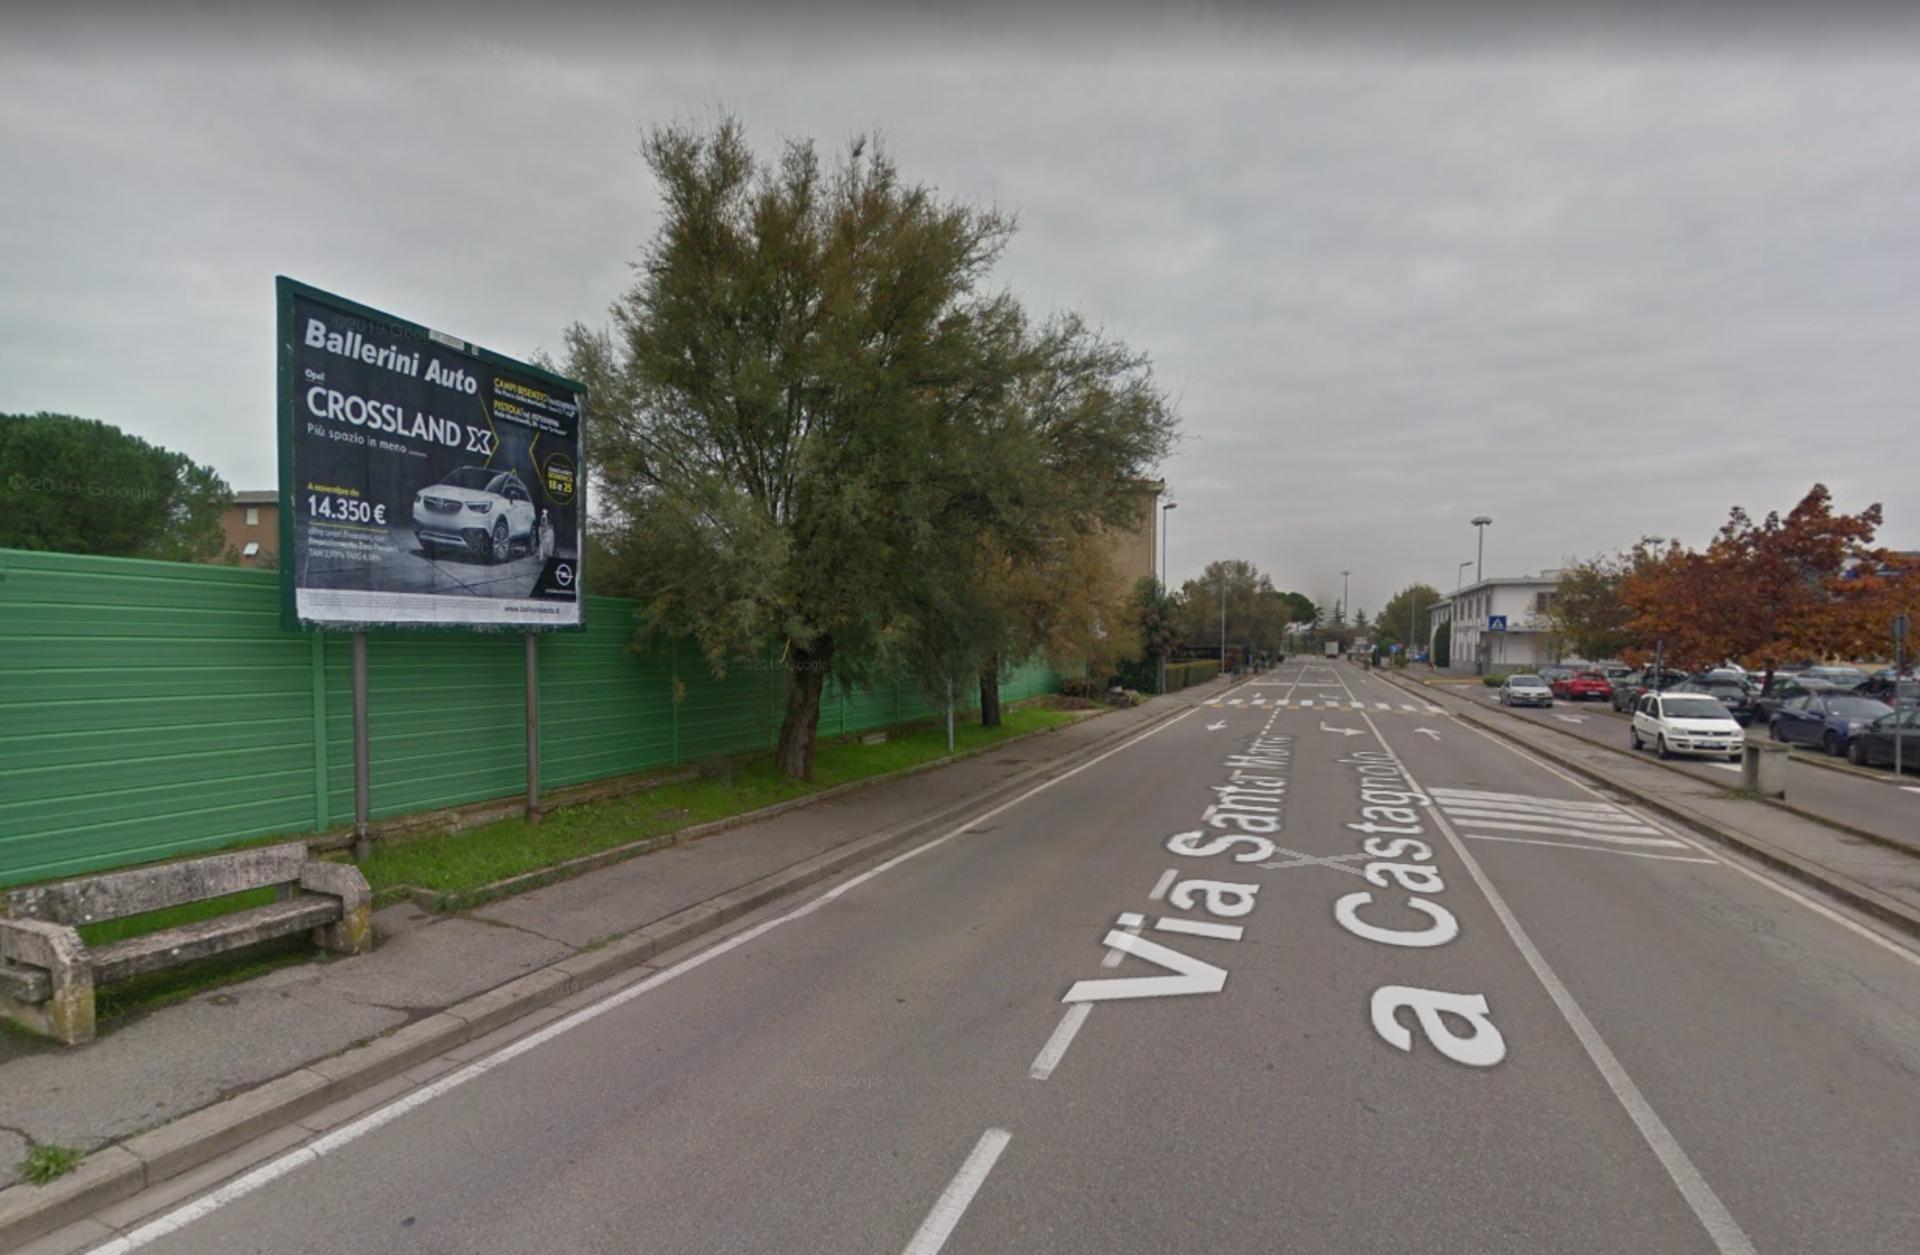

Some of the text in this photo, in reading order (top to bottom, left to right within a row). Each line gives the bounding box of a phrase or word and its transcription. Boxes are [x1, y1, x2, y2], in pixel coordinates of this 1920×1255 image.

[305, 318, 420, 377] Ballerini
[425, 358, 478, 395] Auto
[305, 367, 325, 382] Opel
[307, 386, 462, 447] CROSSLAND
[466, 425, 492, 456] X
[307, 422, 408, 454] Più spazio in meno
[308, 494, 387, 525] 14.350 €
